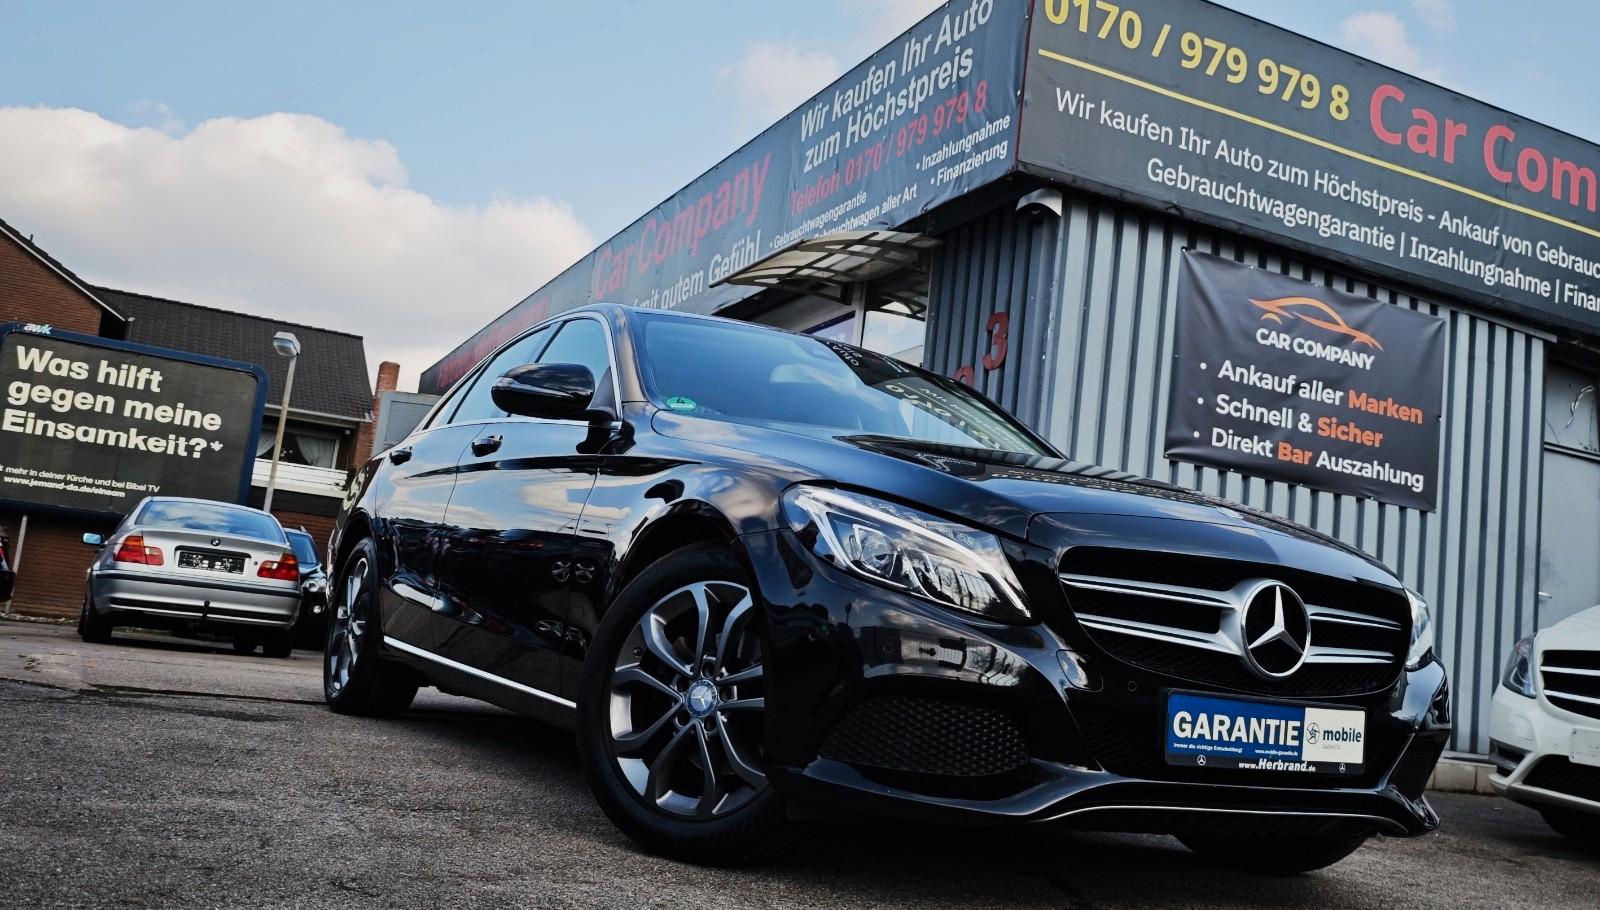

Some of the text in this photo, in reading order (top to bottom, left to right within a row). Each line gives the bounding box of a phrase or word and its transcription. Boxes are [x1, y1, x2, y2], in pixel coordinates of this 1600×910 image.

[801, 0, 993, 142] Wir kaufen Ihr Auto
[1044, 0, 1350, 121] 0170 / 979 979 8
[804, 47, 974, 173] zum Höchstpreis
[790, 170, 840, 216] Telefon
[845, 141, 882, 186] 0170
[896, 114, 928, 159] 979
[932, 91, 968, 136] 979
[974, 80, 988, 113] 8
[922, 115, 1010, 171] Inzahlungnahme
[937, 140, 1008, 186] Finanzierung
[1369, 84, 1597, 213] Car Com
[881, 194, 901, 214] aller
[902, 182, 918, 203] Art
[1056, 87, 1094, 120] Wir
[1100, 100, 1173, 145] kaufen
[1179, 127, 1211, 156] Ihr
[1214, 140, 1263, 172] Auto
[1268, 159, 1308, 190] zum
[1314, 170, 1423, 223] Höchstpreis
[1439, 210, 1500, 247] Ankauf
[1502, 234, 1532, 256] von
[593, 152, 772, 299] Car Company
[774, 190, 867, 248] Gebrauchtwagengarantie
[1147, 158, 1395, 250] Gebrauchtwagengarantie
[1410, 236, 1551, 298] Inzahlungnahme
[660, 269, 703, 311] gutem
[708, 230, 760, 286] Gefühl
[24, 323, 52, 334] awk
[1256, 328, 1375, 370] CAR COMPANY
[16, 346, 162, 392] Was hilft
[1218, 360, 1422, 424] Ankauf aller Marken
[8, 380, 222, 430] gegen meine
[1216, 394, 1384, 448] Schnell & Sicher
[4, 476, 126, 498] www.jemand-da.de/einsam
[6, 466, 160, 493] mehr in deiner Kirche und bei Bibel TV
[1211, 428, 1424, 492] Direkt Bar Auszahlung
[1173, 711, 1300, 747] GARANTIE
[1323, 727, 1362, 742] mobile
[1239, 758, 1316, 772] www.Herbrand.de
